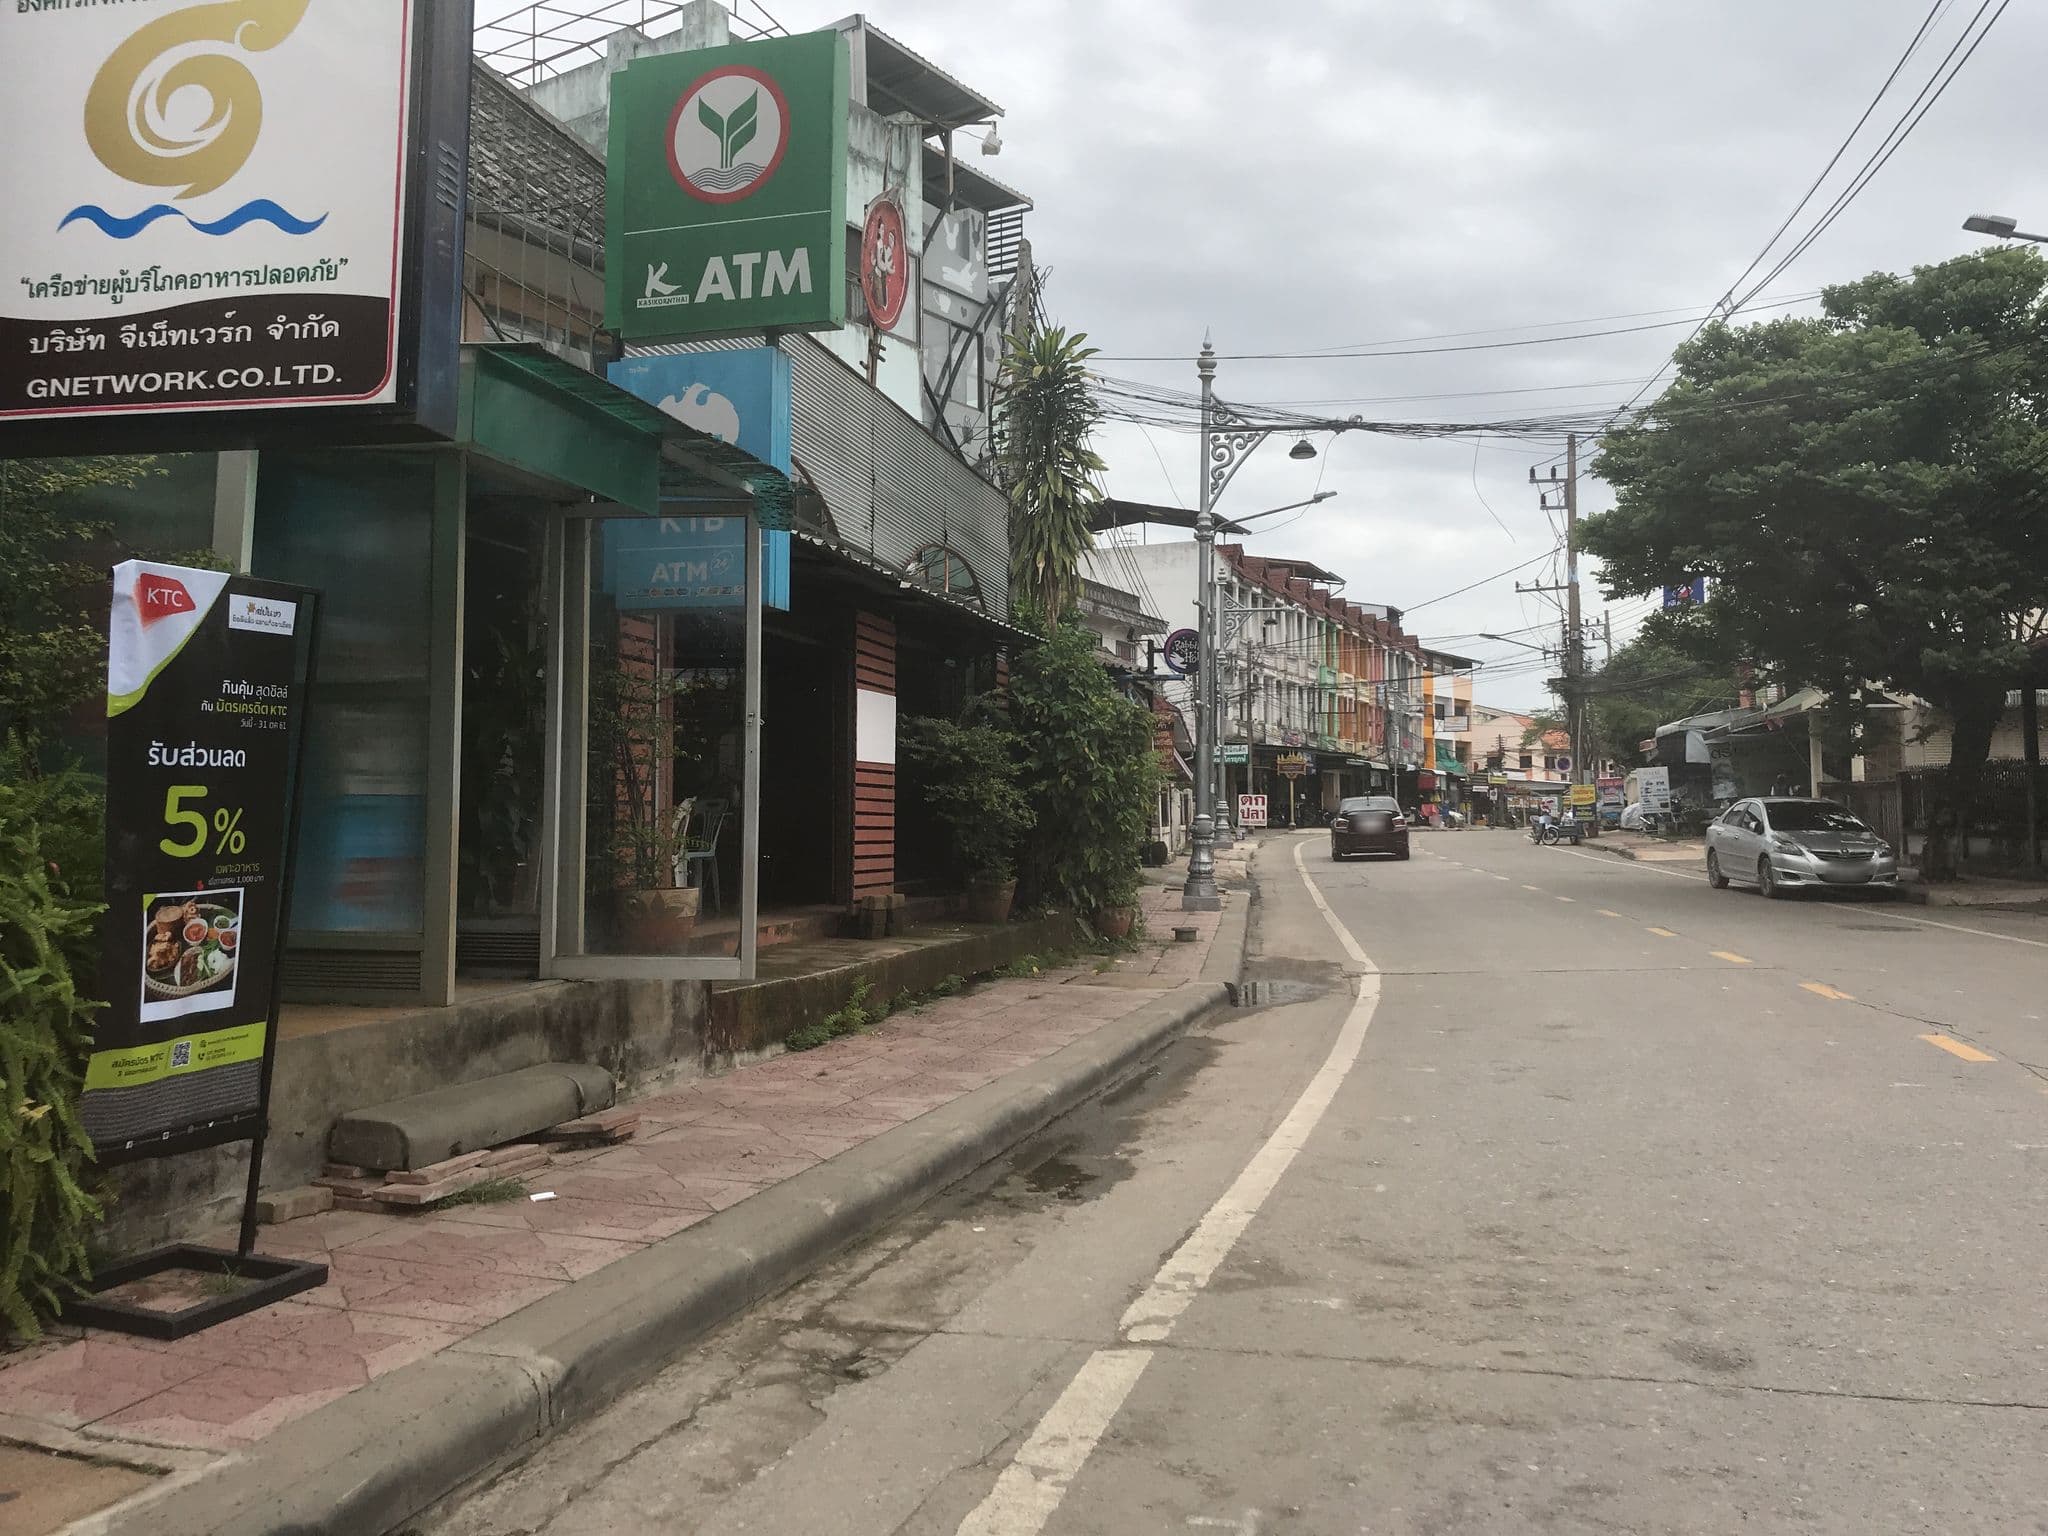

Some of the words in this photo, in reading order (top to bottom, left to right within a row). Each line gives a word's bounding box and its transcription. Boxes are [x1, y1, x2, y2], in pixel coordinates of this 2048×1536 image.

[694, 247, 813, 303] ATM
[29, 327, 105, 354] บริษัท
[266, 313, 340, 341] จำกัด
[26, 363, 343, 399] GNETWORK.CO.LTD.
[651, 561, 708, 582] ATM
[147, 587, 183, 607] KTC
[222, 680, 254, 700] กินคุ้ม
[201, 700, 214, 712] กับ
[216, 698, 269, 715] บัตรเครดิต
[270, 705, 288, 716] KTC
[148, 740, 246, 767] รับส่วนลด
[160, 785, 245, 857] 5%
[1240, 807, 1265, 819] ปลา
